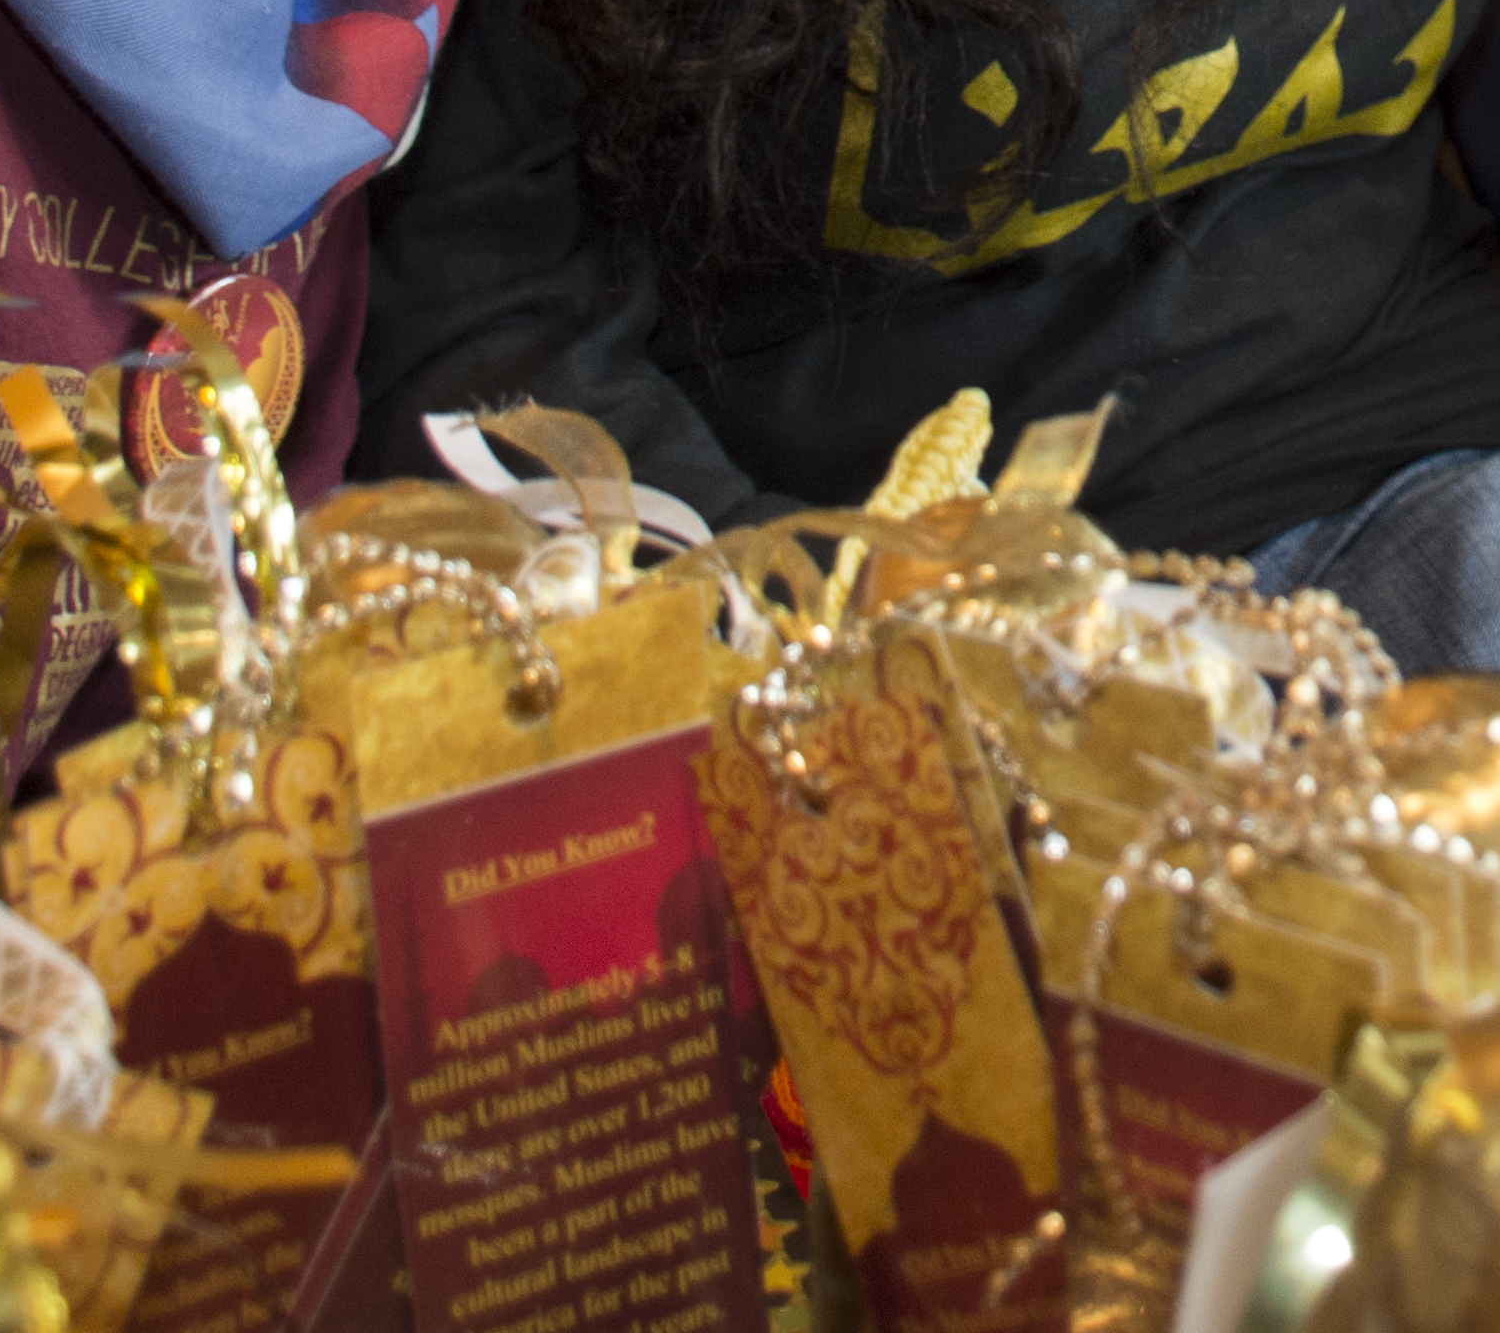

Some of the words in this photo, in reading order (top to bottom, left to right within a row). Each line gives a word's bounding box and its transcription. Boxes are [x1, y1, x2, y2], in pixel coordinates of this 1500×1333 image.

[444, 859, 498, 901] Did
[504, 846, 558, 882] You
[562, 811, 655, 865] Know?
[409, 1053, 511, 1105] million
[518, 1017, 635, 1068] Muslims
[640, 994, 691, 1030] live
[697, 982, 726, 1013] in
[435, 965, 638, 1052] Approximately
[425, 1110, 469, 1143] the
[475, 1071, 570, 1128] United
[574, 1055, 665, 1097] States,
[669, 1023, 719, 1066] and
[518, 1128, 562, 1160] are
[567, 1104, 628, 1144] over
[637, 1073, 712, 1121] 1,200
[418, 1183, 545, 1239] mosques.
[554, 1138, 672, 1194] Muslims
[676, 1113, 740, 1153] have
[468, 1227, 536, 1268] been
[542, 1219, 560, 1244] a
[564, 1196, 619, 1243] part
[624, 1179, 653, 1216] of
[660, 1170, 702, 1204] the
[452, 1256, 557, 1321] cultural
[563, 1218, 695, 1282] landscape
[701, 1204, 729, 1234] in
[584, 1289, 621, 1319] for
[628, 1271, 671, 1304] the
[677, 1247, 731, 1296] past
